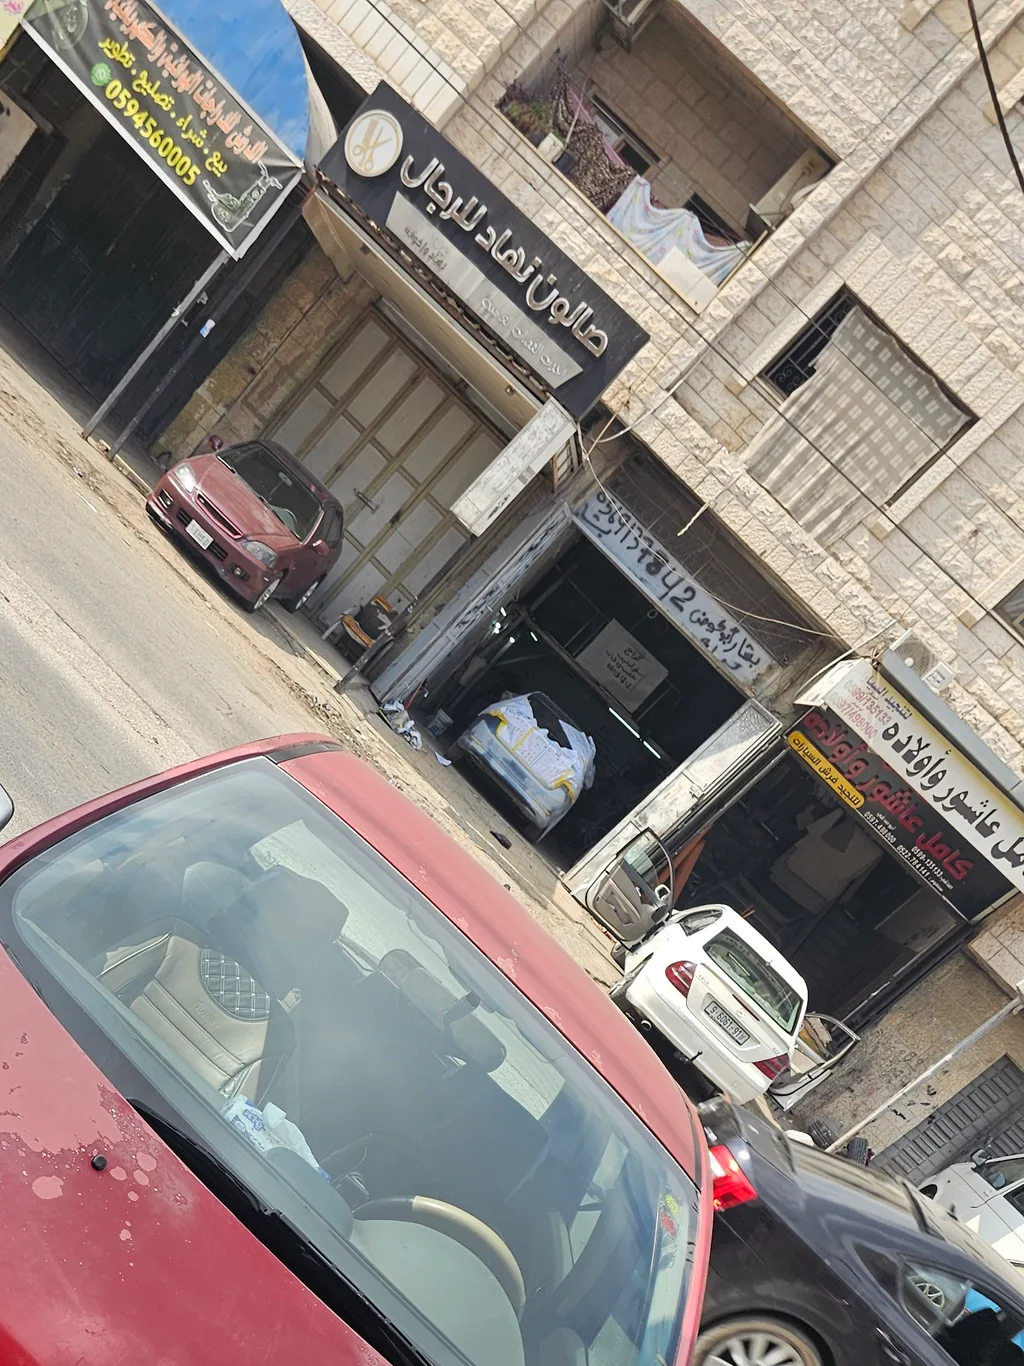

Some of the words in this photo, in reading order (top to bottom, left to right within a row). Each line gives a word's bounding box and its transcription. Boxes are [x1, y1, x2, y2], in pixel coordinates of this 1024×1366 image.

[98, 38, 135, 69] تطوير
[132, 70, 175, 112] تصليح
[193, 81, 242, 134] للدراجات
[105, 79, 201, 186] 0594560005
[176, 115, 208, 149] شراء
[205, 151, 228, 177] بيع
[400, 155, 487, 231] للرجال
[475, 226, 543, 283] نهاد
[526, 274, 608, 357] صالون
[723, 637, 761, 668] بشار
[885, 695, 913, 720] لتنجيد
[793, 738, 821, 766] السيارات
[803, 711, 868, 779] وأولاده
[881, 722, 951, 791] وأولاده
[819, 766, 838, 784] فرش
[837, 783, 861, 806] لتنجيد
[857, 776, 923, 833] عاشور
[932, 787, 1000, 839] عاشور
[915, 831, 975, 881] كامل
